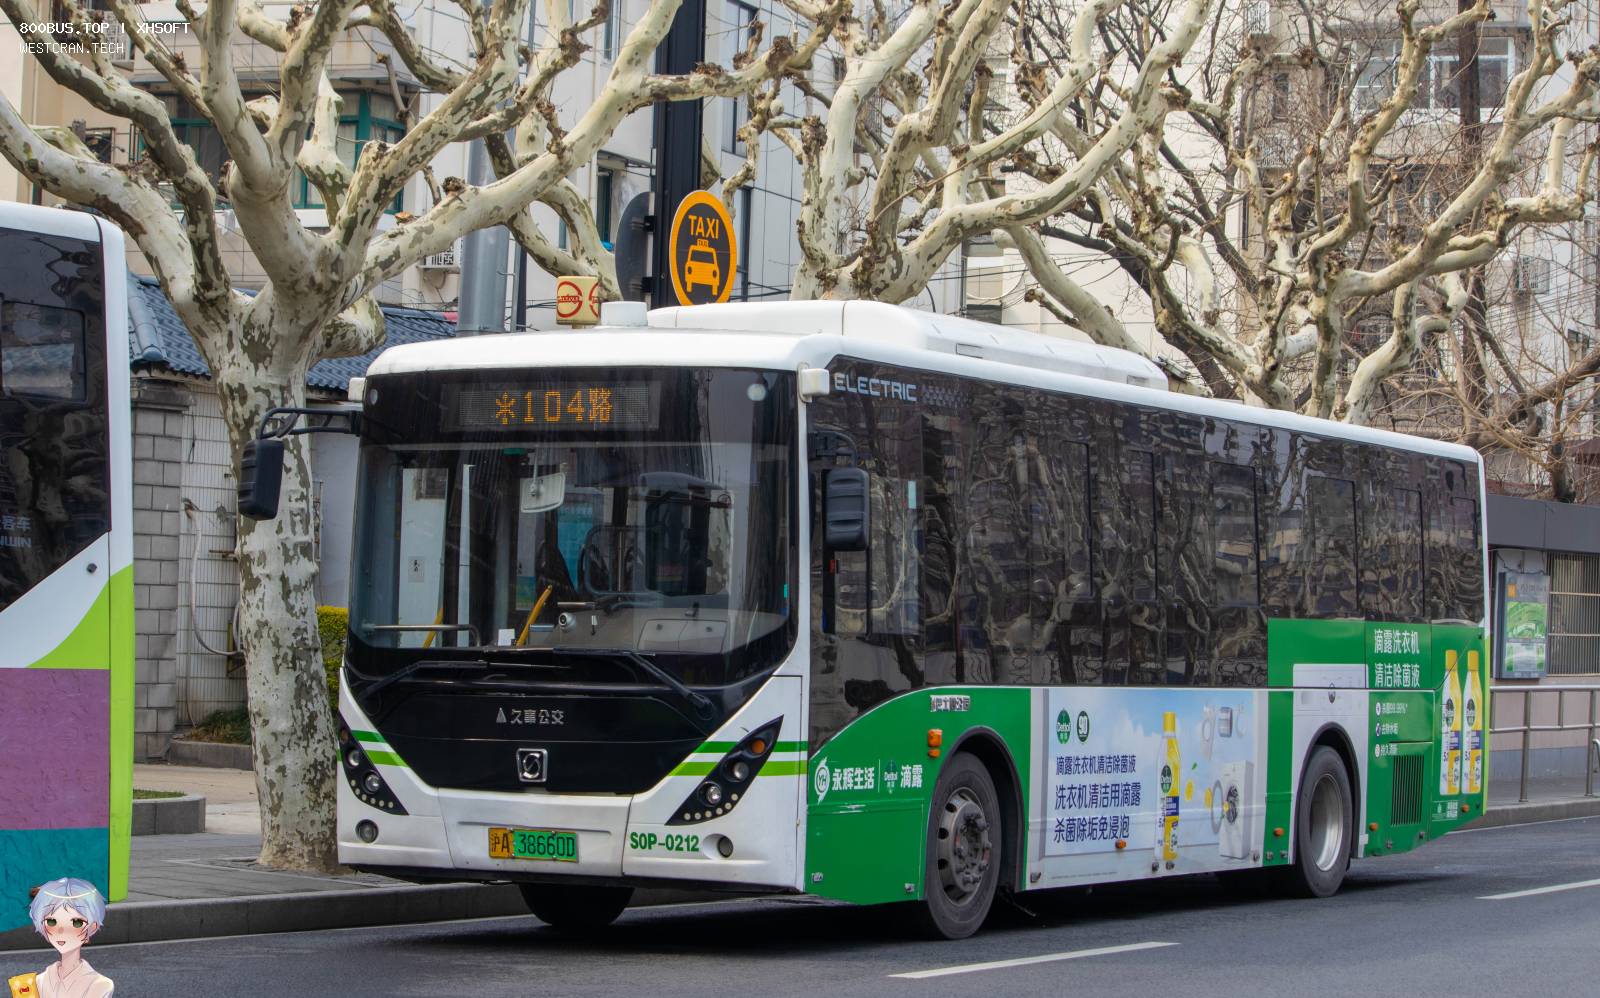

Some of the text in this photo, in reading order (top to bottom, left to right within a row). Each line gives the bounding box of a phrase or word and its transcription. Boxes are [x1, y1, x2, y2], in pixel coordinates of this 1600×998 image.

[688, 215, 719, 239] TAXI
[834, 372, 918, 402] ELECTRIC
[1374, 629, 1420, 655] 滴露洗衣机
[1374, 663, 1420, 688] 清洁除菌液
[900, 764, 922, 789] 滴露
[1056, 754, 1136, 776] 滴露洗衣机清洁除菌液
[831, 767, 875, 791] 永辉生活
[1055, 782, 1141, 810] 洗衣机清洁用滴露
[1053, 814, 1130, 843] 杀菌除垢免浸泡
